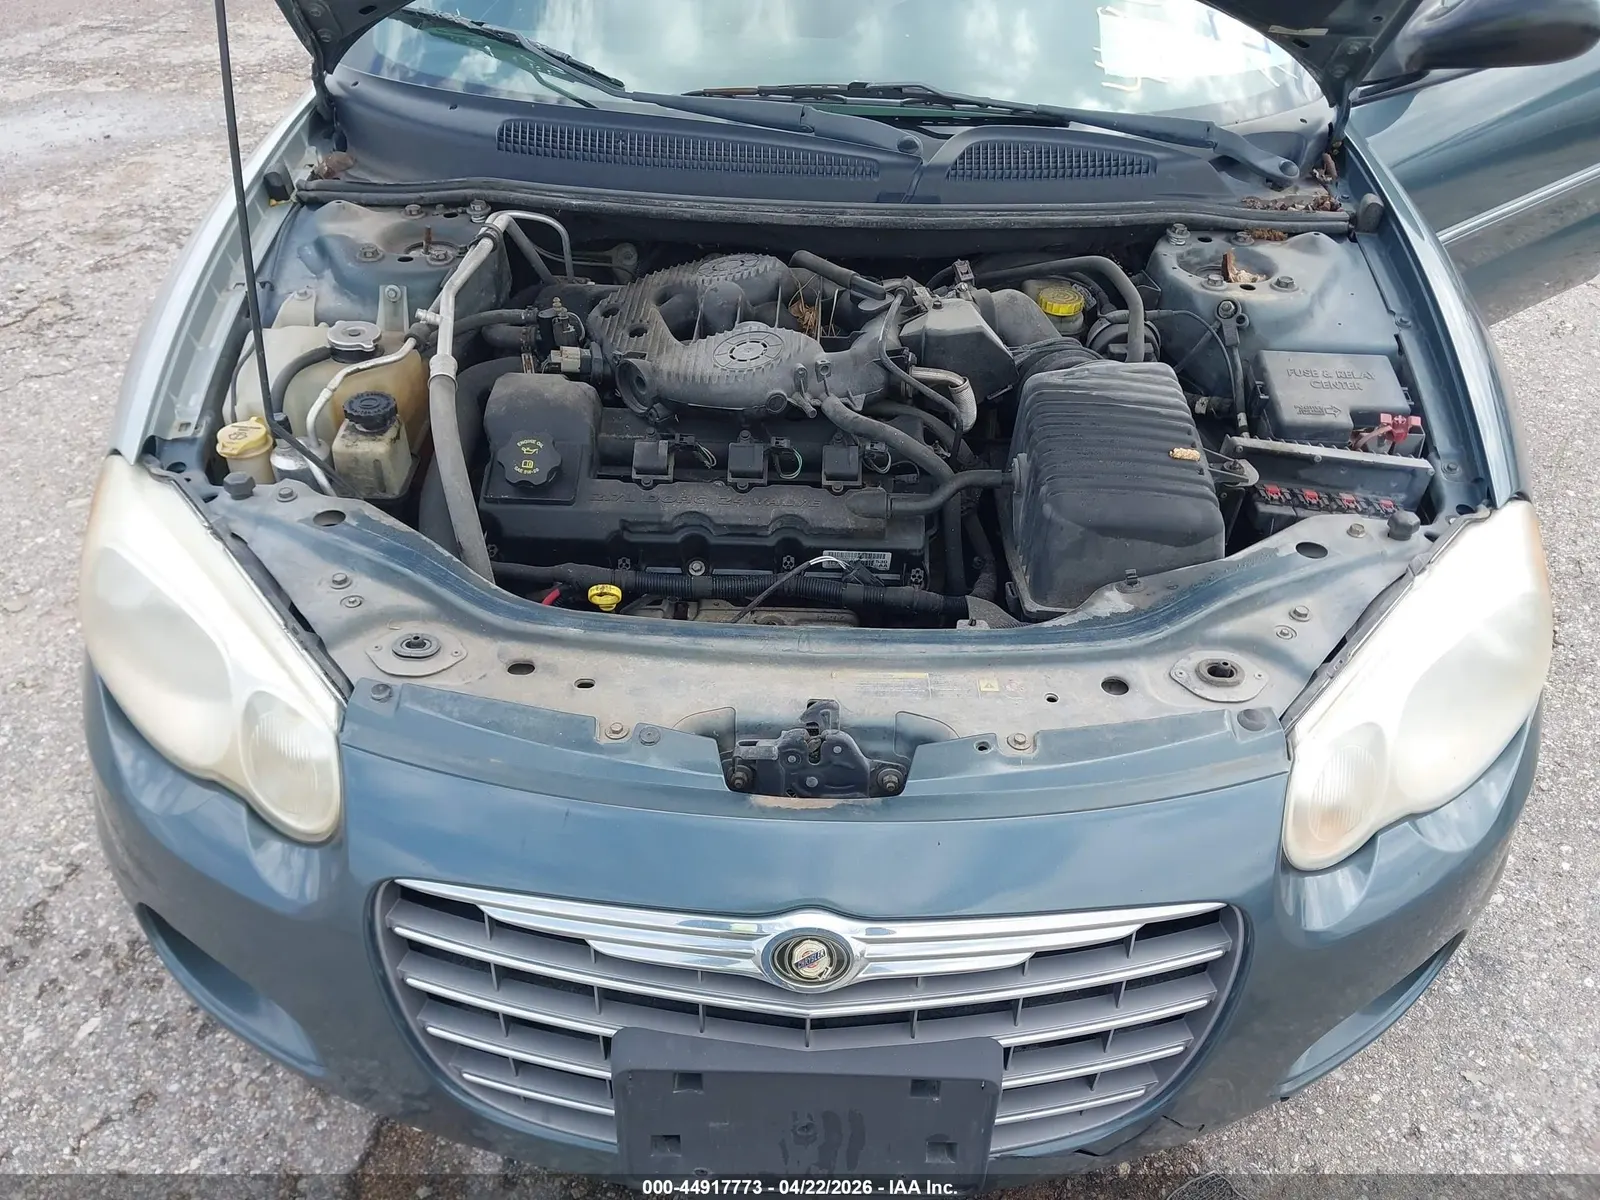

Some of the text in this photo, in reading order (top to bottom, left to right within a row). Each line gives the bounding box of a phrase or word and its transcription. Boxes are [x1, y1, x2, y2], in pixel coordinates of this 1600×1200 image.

[1286, 368, 1376, 381] FUSE & RELAY
[1309, 380, 1364, 391] CENTER
